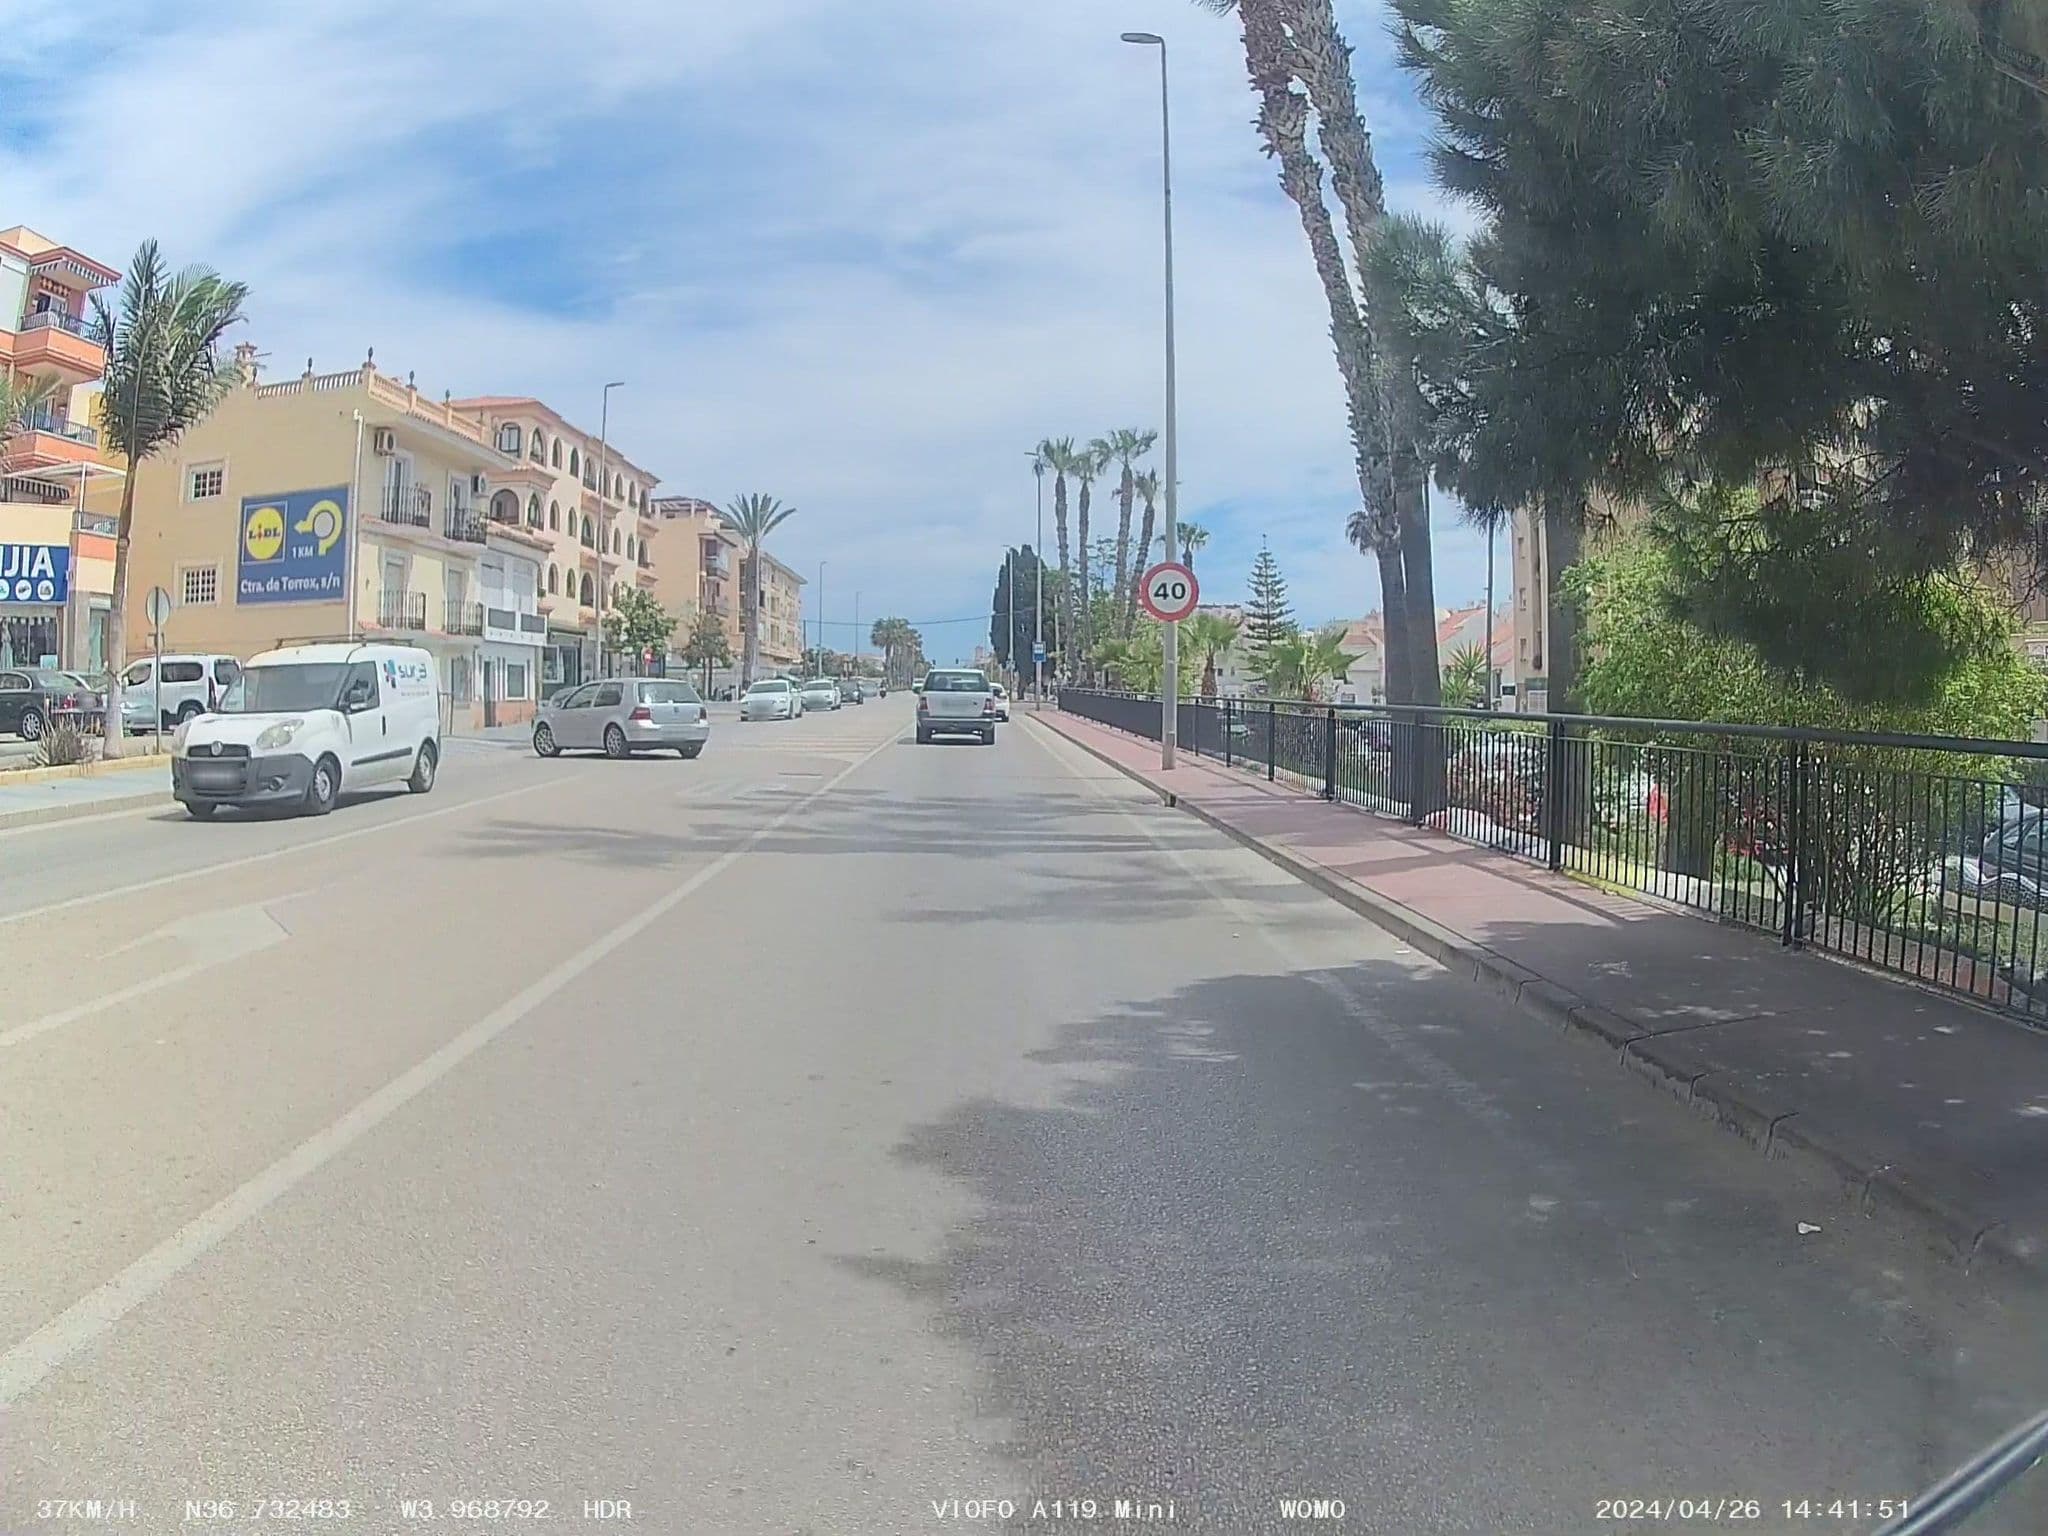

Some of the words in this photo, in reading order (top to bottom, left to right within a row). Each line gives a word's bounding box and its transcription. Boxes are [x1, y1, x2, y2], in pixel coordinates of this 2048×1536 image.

[292, 547, 298, 559] 1
[298, 546, 314, 558] KM
[1153, 582, 1186, 600] 40
